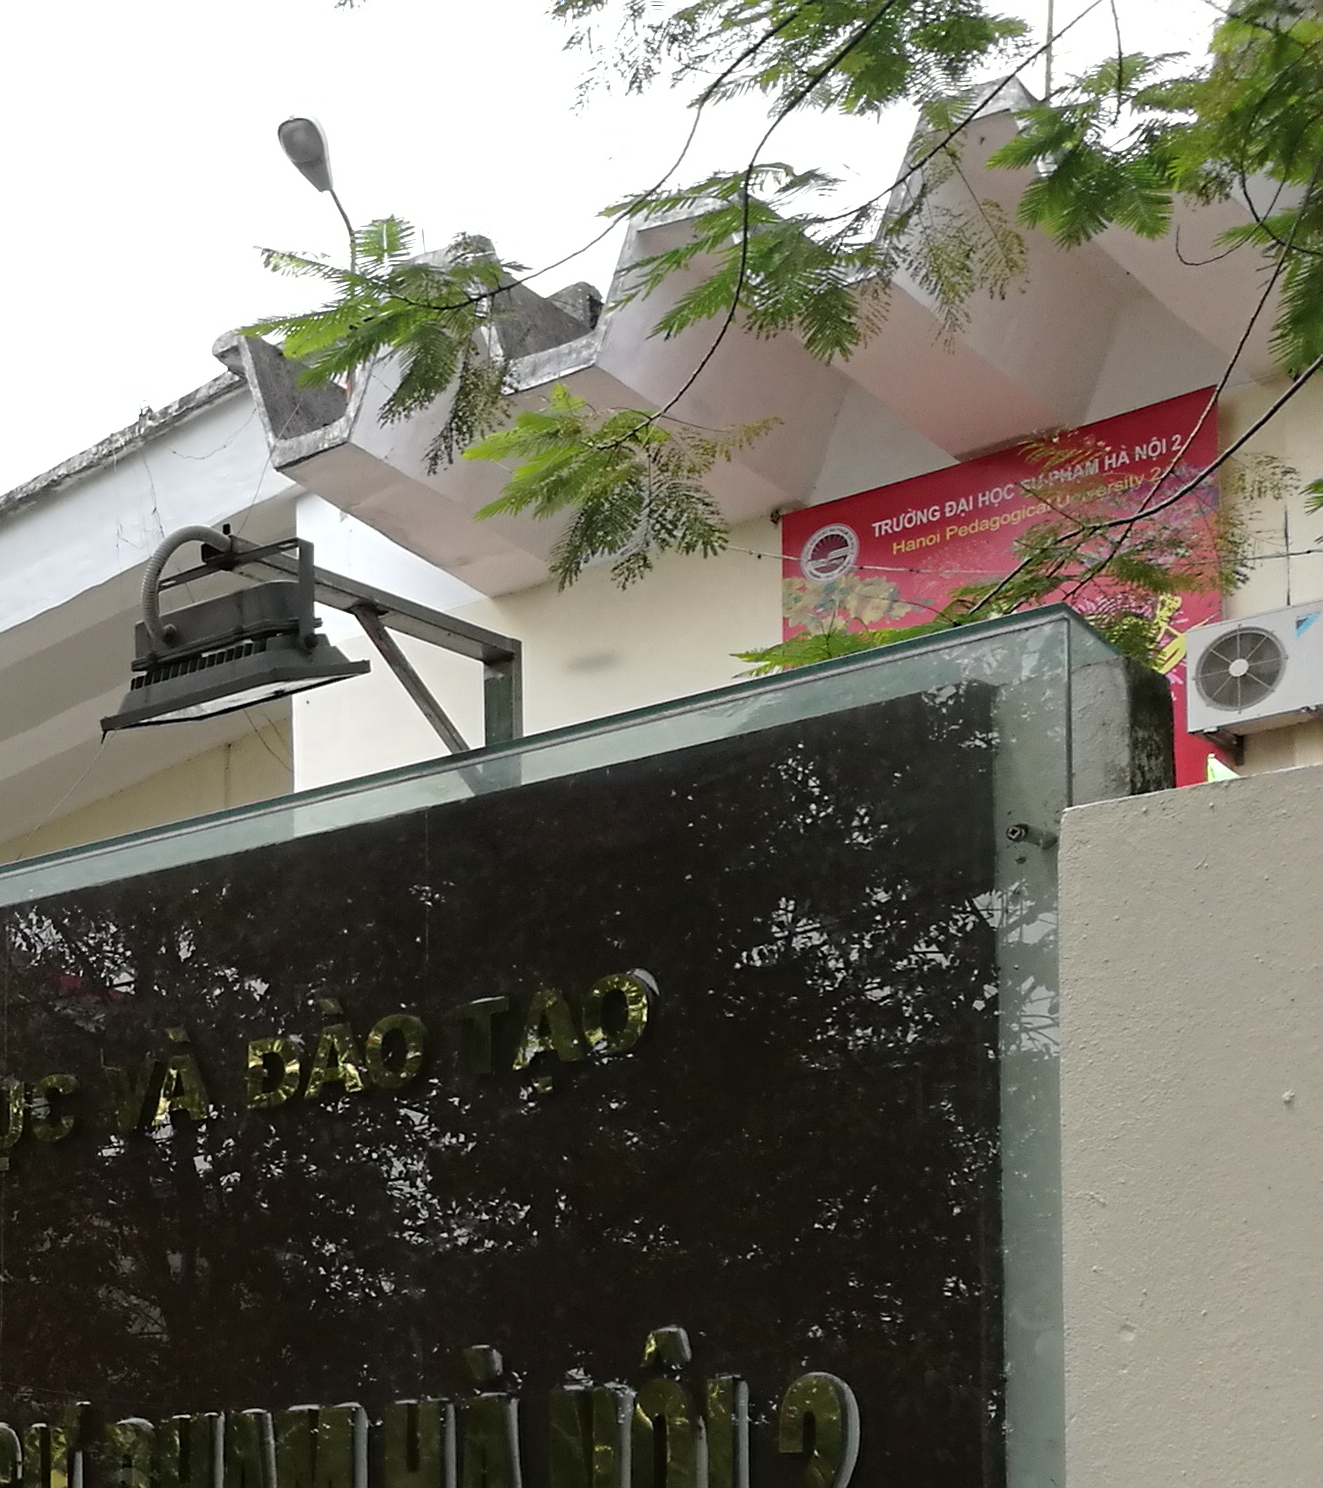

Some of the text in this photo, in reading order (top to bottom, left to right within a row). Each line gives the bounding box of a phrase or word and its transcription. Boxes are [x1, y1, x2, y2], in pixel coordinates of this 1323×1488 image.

[871, 508, 941, 539] TRƯỜNG
[944, 495, 974, 517] ĐẠI
[977, 484, 1016, 507] HỌC
[1103, 444, 1131, 470] HÀ
[1134, 436, 1167, 461] NỘI
[1170, 433, 1183, 452] 2
[891, 530, 942, 555] Hanoi
[944, 498, 1051, 542] Pedagogical
[101, 1026, 211, 1142] VÀ
[246, 996, 432, 1110] ĐÀO
[456, 967, 661, 1095] TẠO
